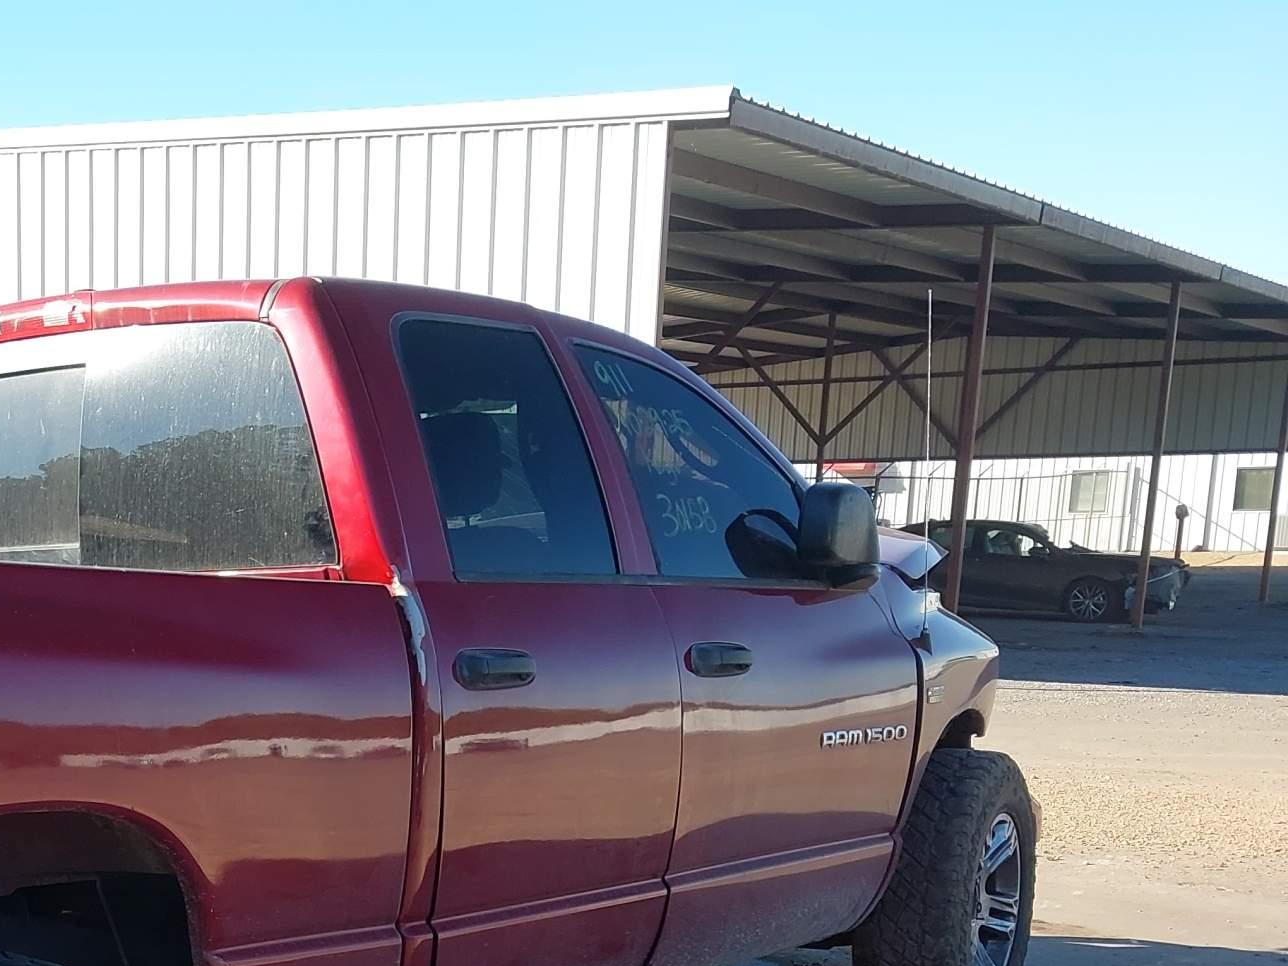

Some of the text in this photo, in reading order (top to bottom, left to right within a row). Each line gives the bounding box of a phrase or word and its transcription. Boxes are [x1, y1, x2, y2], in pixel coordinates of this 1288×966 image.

[593, 360, 634, 398] 911
[820, 724, 908, 748] RAM 1500
